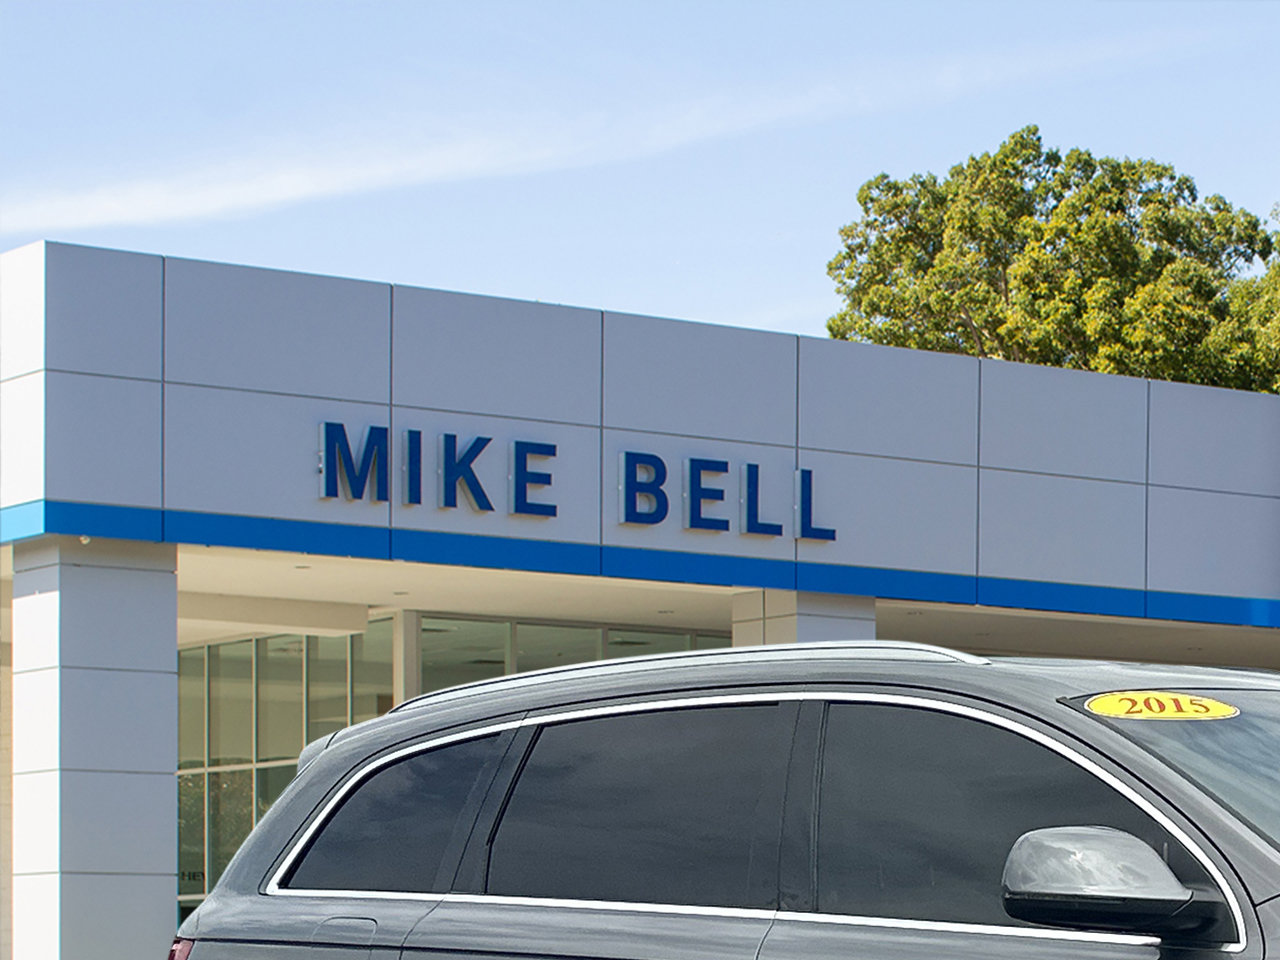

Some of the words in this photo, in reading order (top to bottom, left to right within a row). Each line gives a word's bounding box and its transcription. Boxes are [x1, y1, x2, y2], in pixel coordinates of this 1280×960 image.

[319, 421, 558, 518] MIKE
[618, 450, 837, 541] BELL
[1118, 696, 1210, 715] 2015
